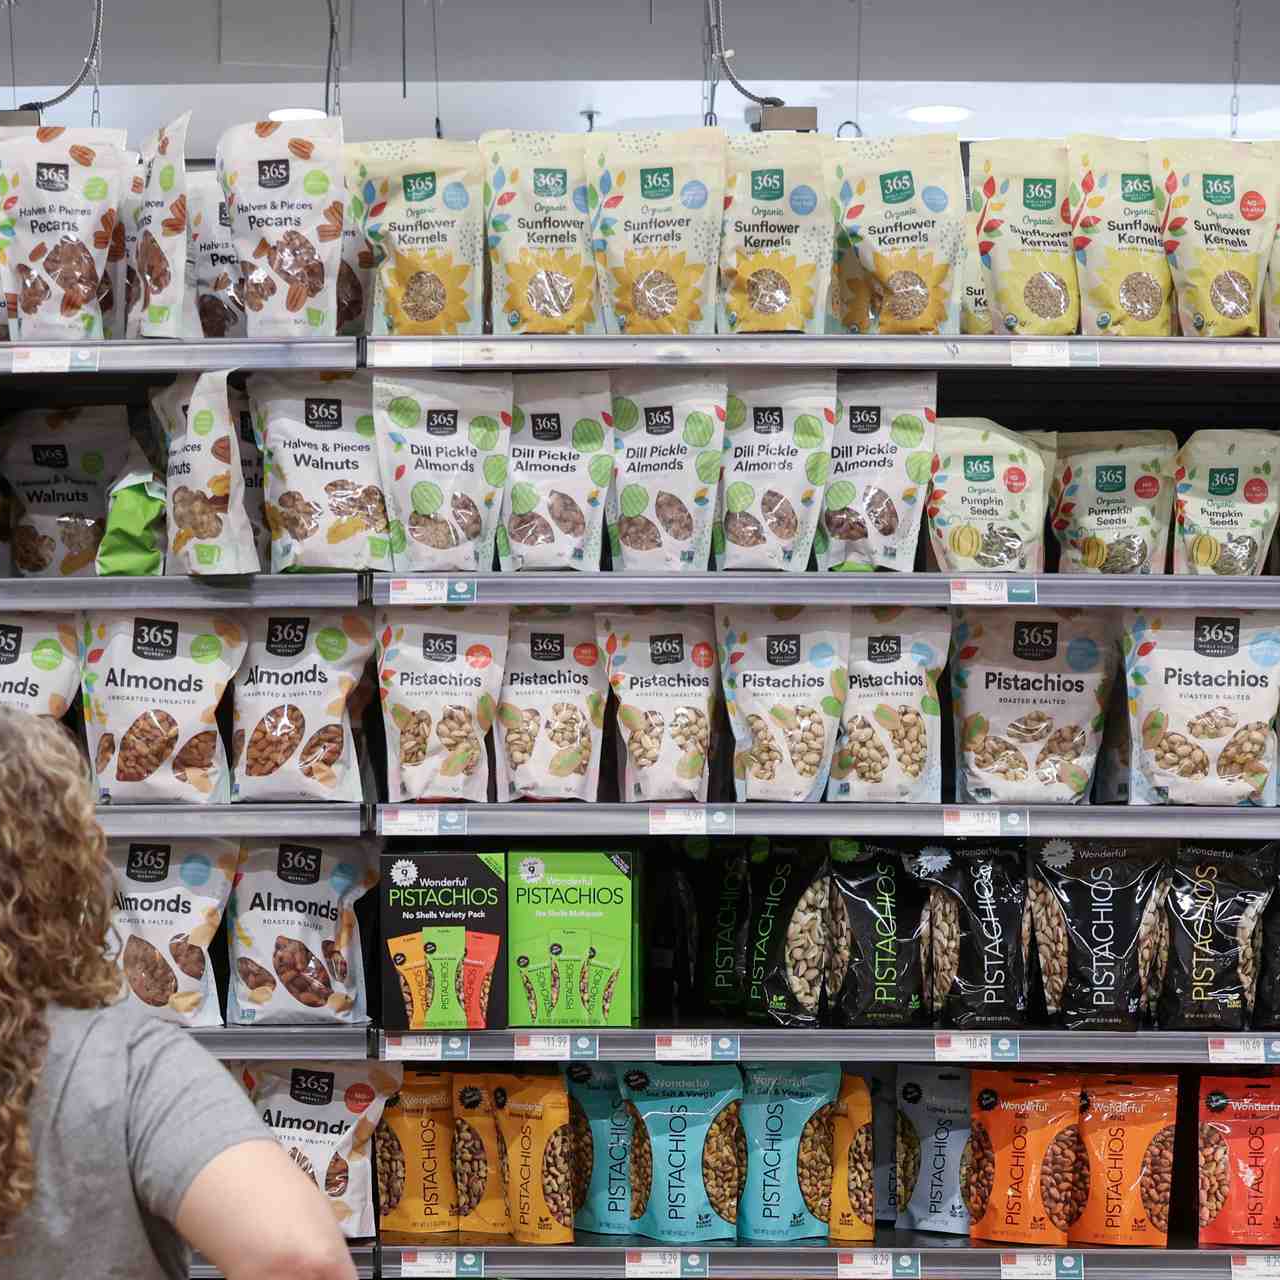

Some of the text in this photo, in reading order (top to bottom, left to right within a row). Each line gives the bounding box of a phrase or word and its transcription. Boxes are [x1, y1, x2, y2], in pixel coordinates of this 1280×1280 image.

[262, 166, 288, 180] 365
[754, 172, 780, 190] 365
[248, 213, 302, 228] Pecans
[734, 220, 800, 236] Sunflower
[743, 236, 790, 248] Kernels
[309, 404, 337, 420] 365
[429, 413, 454, 426] 365
[282, 440, 318, 452] Halves
[334, 442, 370, 454] Pieces
[410, 445, 477, 458] Dill Pickle
[294, 455, 359, 471] Walnuts
[414, 458, 474, 473] Almonds
[961, 497, 1004, 510] Pumpkin
[969, 505, 999, 516] Seeds
[138, 625, 172, 646] 365
[1022, 626, 1053, 646] 365
[427, 638, 453, 655] 365
[105, 669, 203, 692] Almonds
[400, 672, 482, 688] Pistachios
[985, 672, 1084, 692] Pistachios
[1164, 668, 1268, 688] Pistachios
[282, 851, 316, 871] 365
[420, 876, 467, 889] Wonderful
[388, 888, 498, 907] PISTACHIOS
[516, 887, 624, 906] PISTACHIOS
[249, 893, 338, 921] Almonds
[402, 910, 486, 920] No Shells Variety Pack
[875, 864, 895, 1002] PISTACHIOS
[1092, 865, 1114, 1005] PISTACHIOS
[1000, 1101, 1047, 1113] Wonderful
[424, 1118, 435, 1215] PISTACHIOS
[668, 1104, 686, 1220] PISTACHIOS
[1006, 1126, 1028, 1225] PISTACHIOS
[1248, 1126, 1264, 1226] PISTACHIOS
